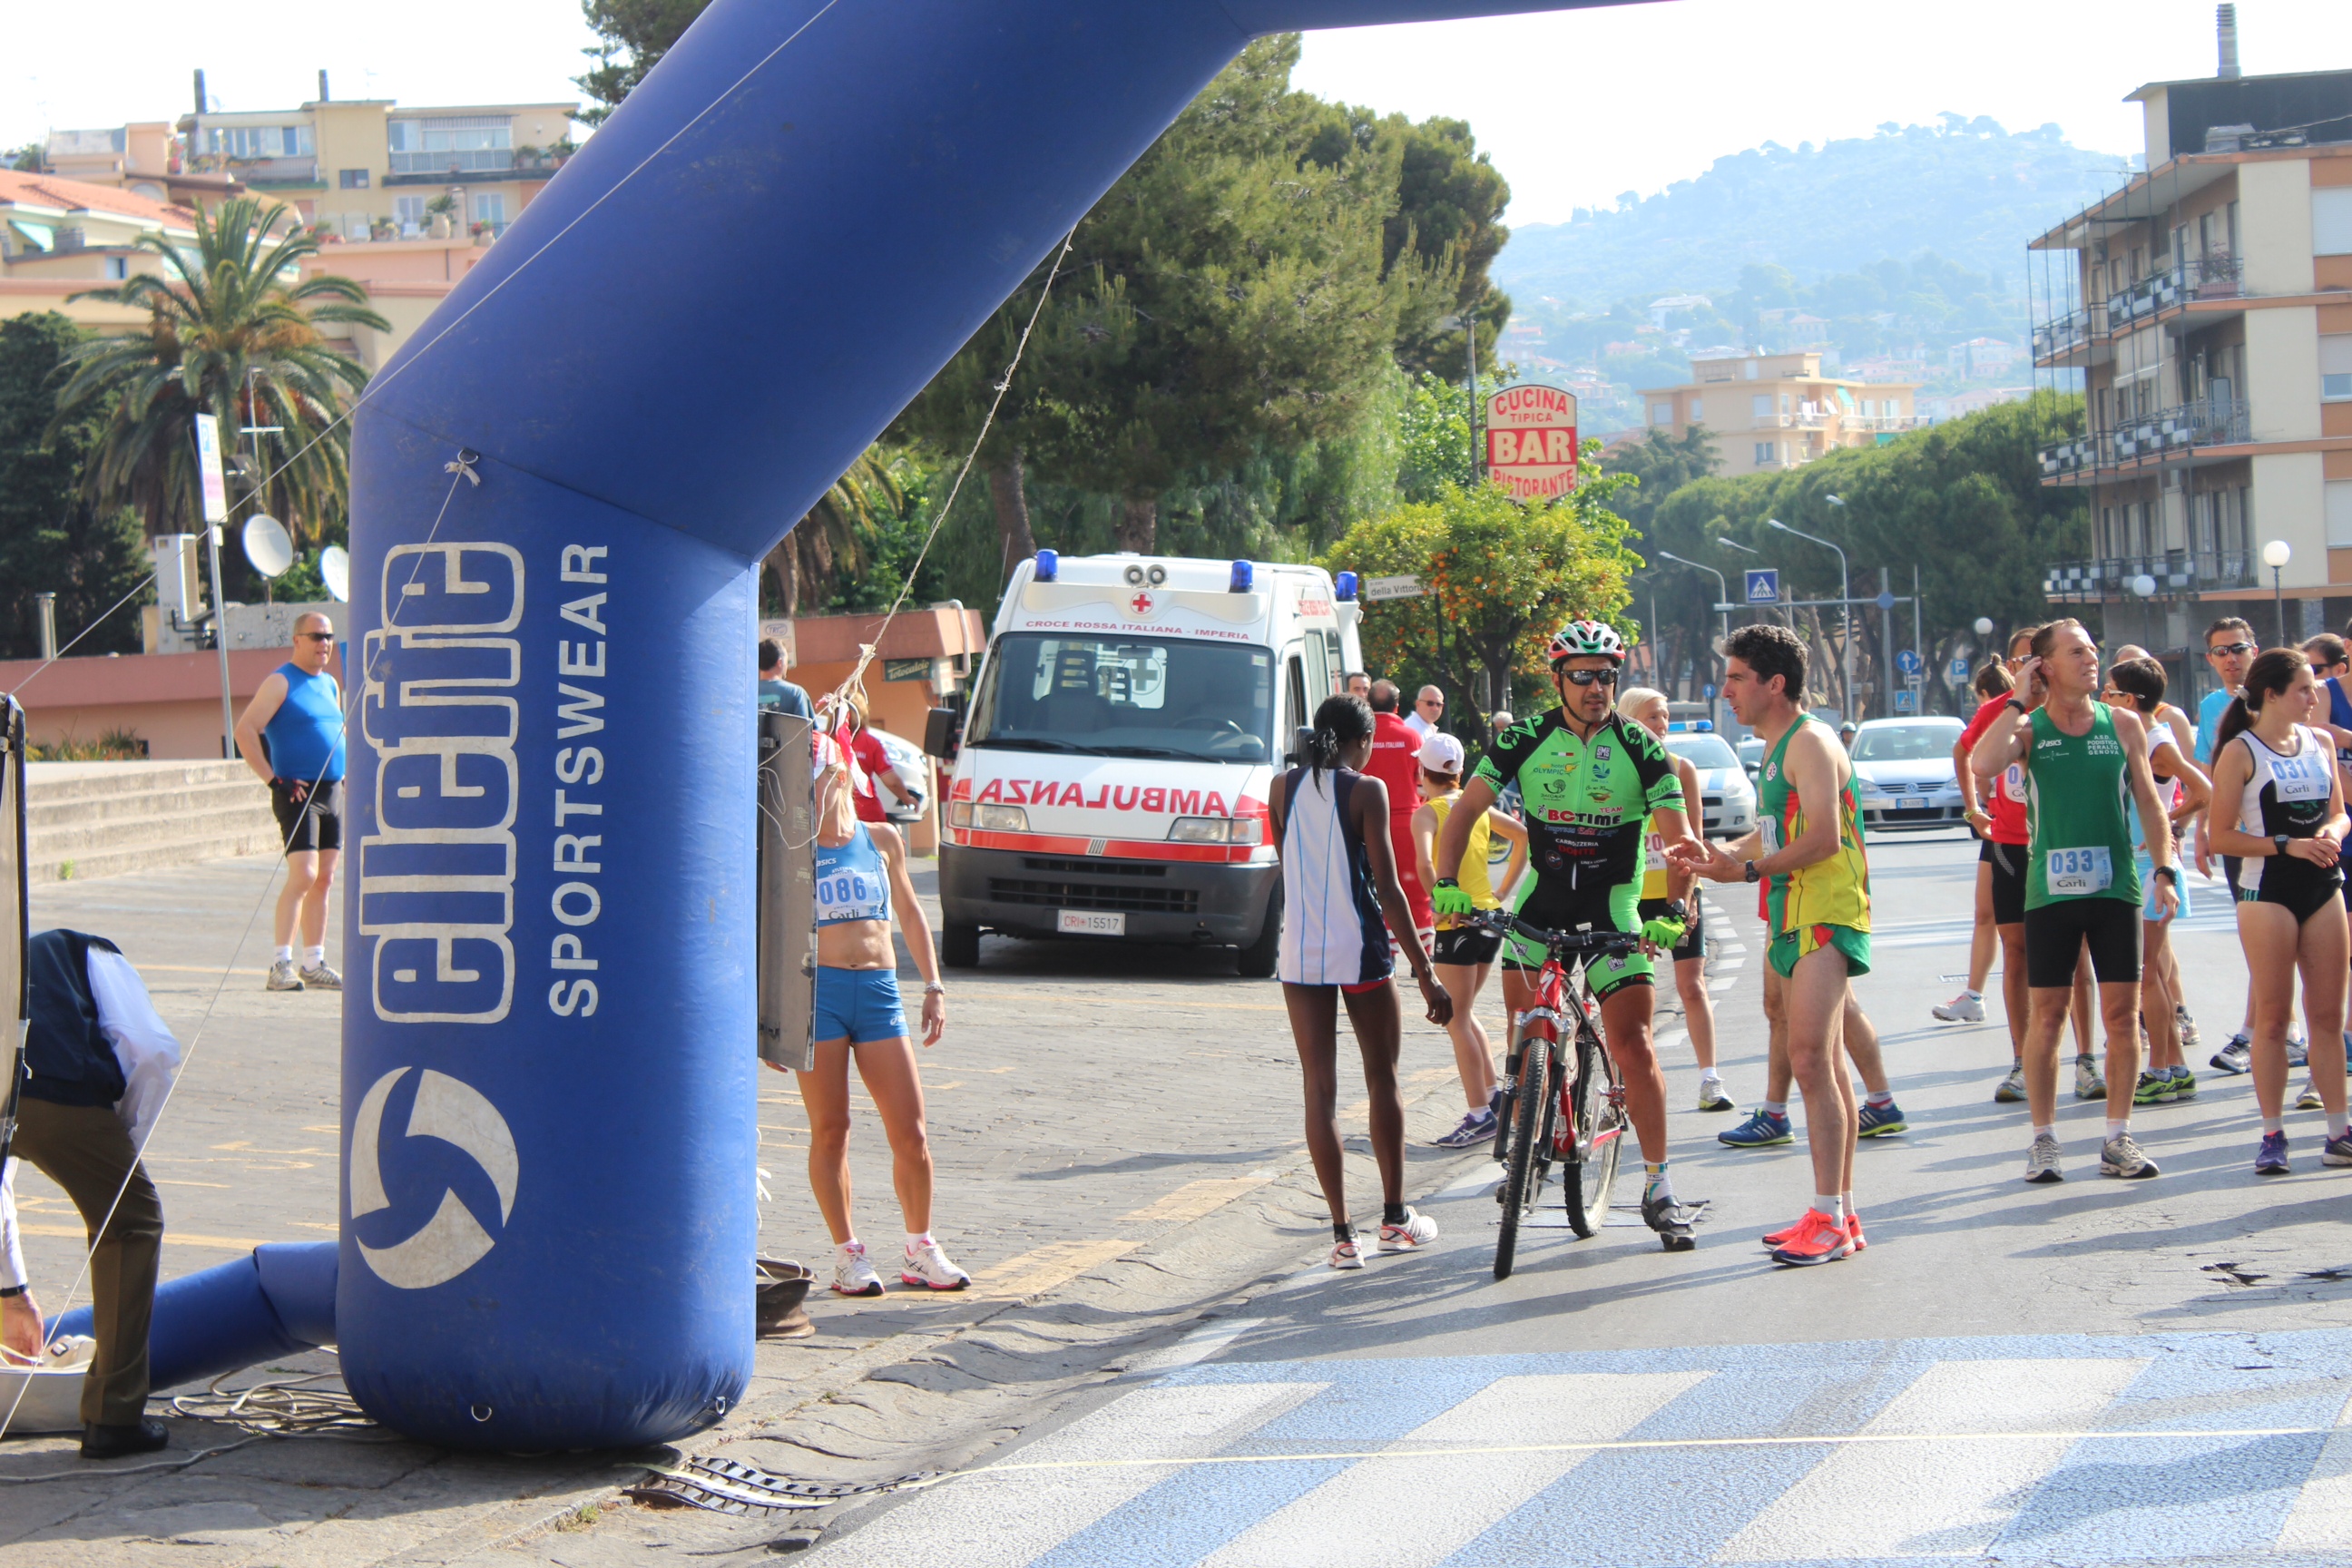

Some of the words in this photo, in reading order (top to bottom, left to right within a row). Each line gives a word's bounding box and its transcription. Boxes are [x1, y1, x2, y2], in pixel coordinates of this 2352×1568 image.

[1495, 388, 1568, 416] CUCINA
[1511, 413, 1553, 422] TIPICA
[1494, 430, 1572, 465] BAR
[1371, 587, 1391, 596] della
[1074, 622, 1117, 630] ROSSA
[1122, 623, 1183, 634] ITALIANA
[1195, 629, 1250, 641] IMPERIA
[1534, 767, 1564, 776] OLYMPIC
[2272, 760, 2309, 779] 031
[358, 541, 524, 1024] elleffe
[548, 543, 608, 1017] SPORTSWEAR
[2285, 785, 2310, 795] Carli
[2052, 850, 2093, 874] 033
[818, 876, 867, 905] 086
[2056, 878, 2087, 888] Carli
[828, 908, 859, 919] Carli
[1063, 916, 1080, 927] CRI
[1088, 916, 1120, 930] 15517
